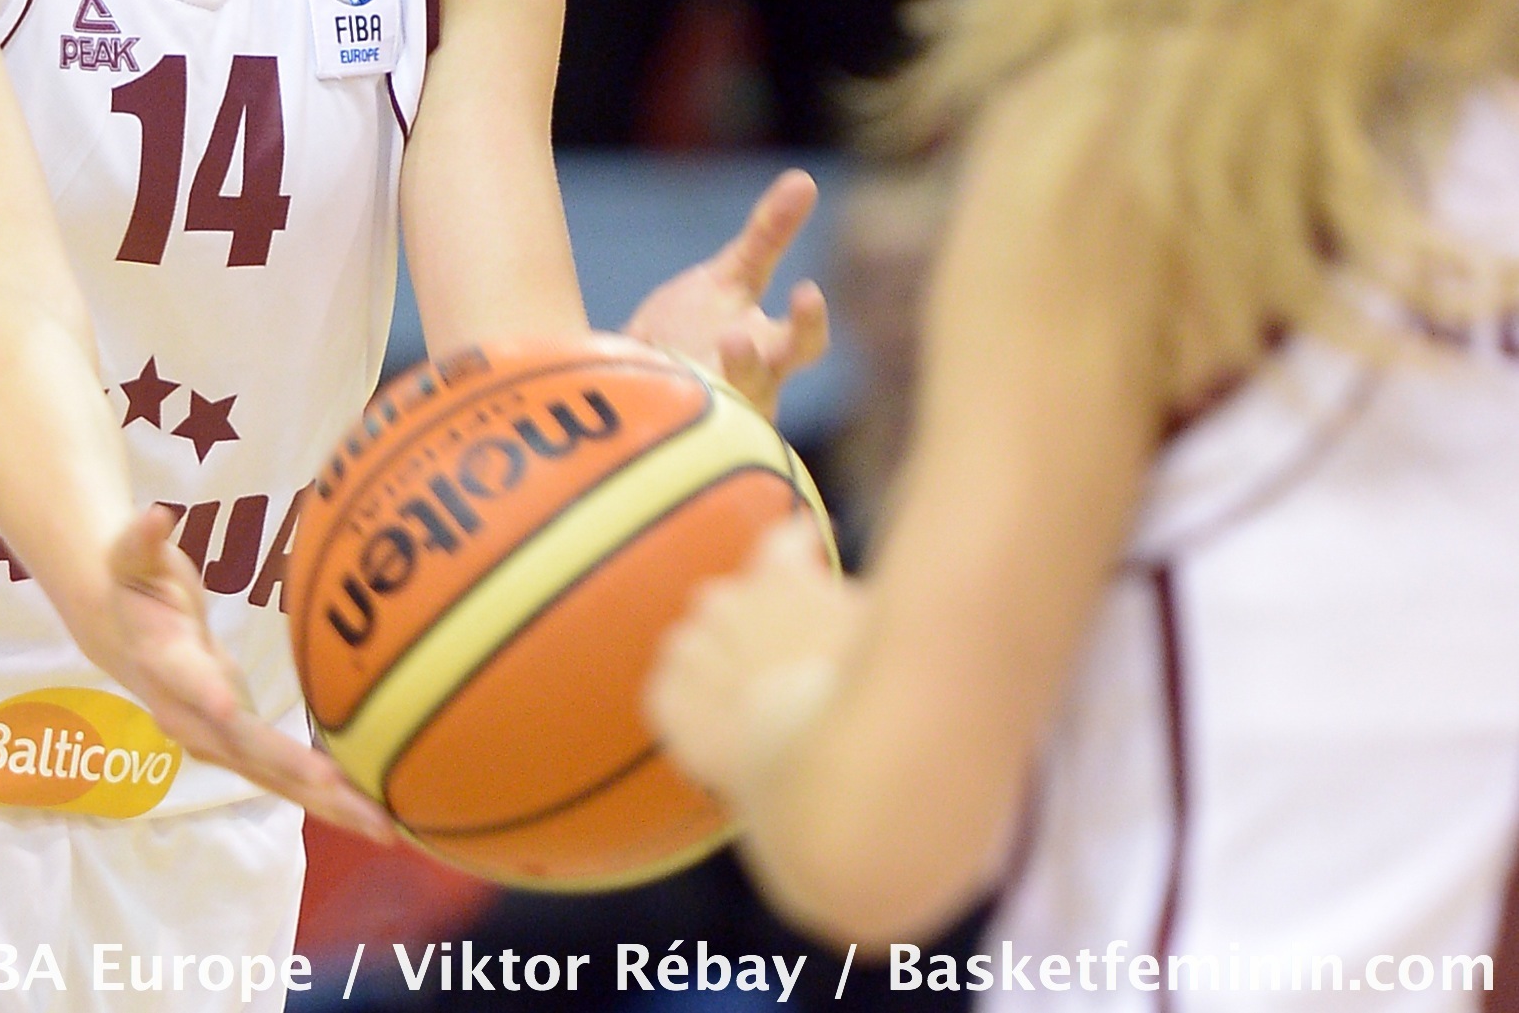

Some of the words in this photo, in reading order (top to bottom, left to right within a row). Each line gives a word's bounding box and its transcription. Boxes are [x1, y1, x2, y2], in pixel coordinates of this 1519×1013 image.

[335, 14, 381, 44] FIBA
[59, 35, 140, 72] PEAK
[340, 47, 380, 64] EUROPE
[110, 54, 292, 268] 14
[324, 390, 622, 648] molten
